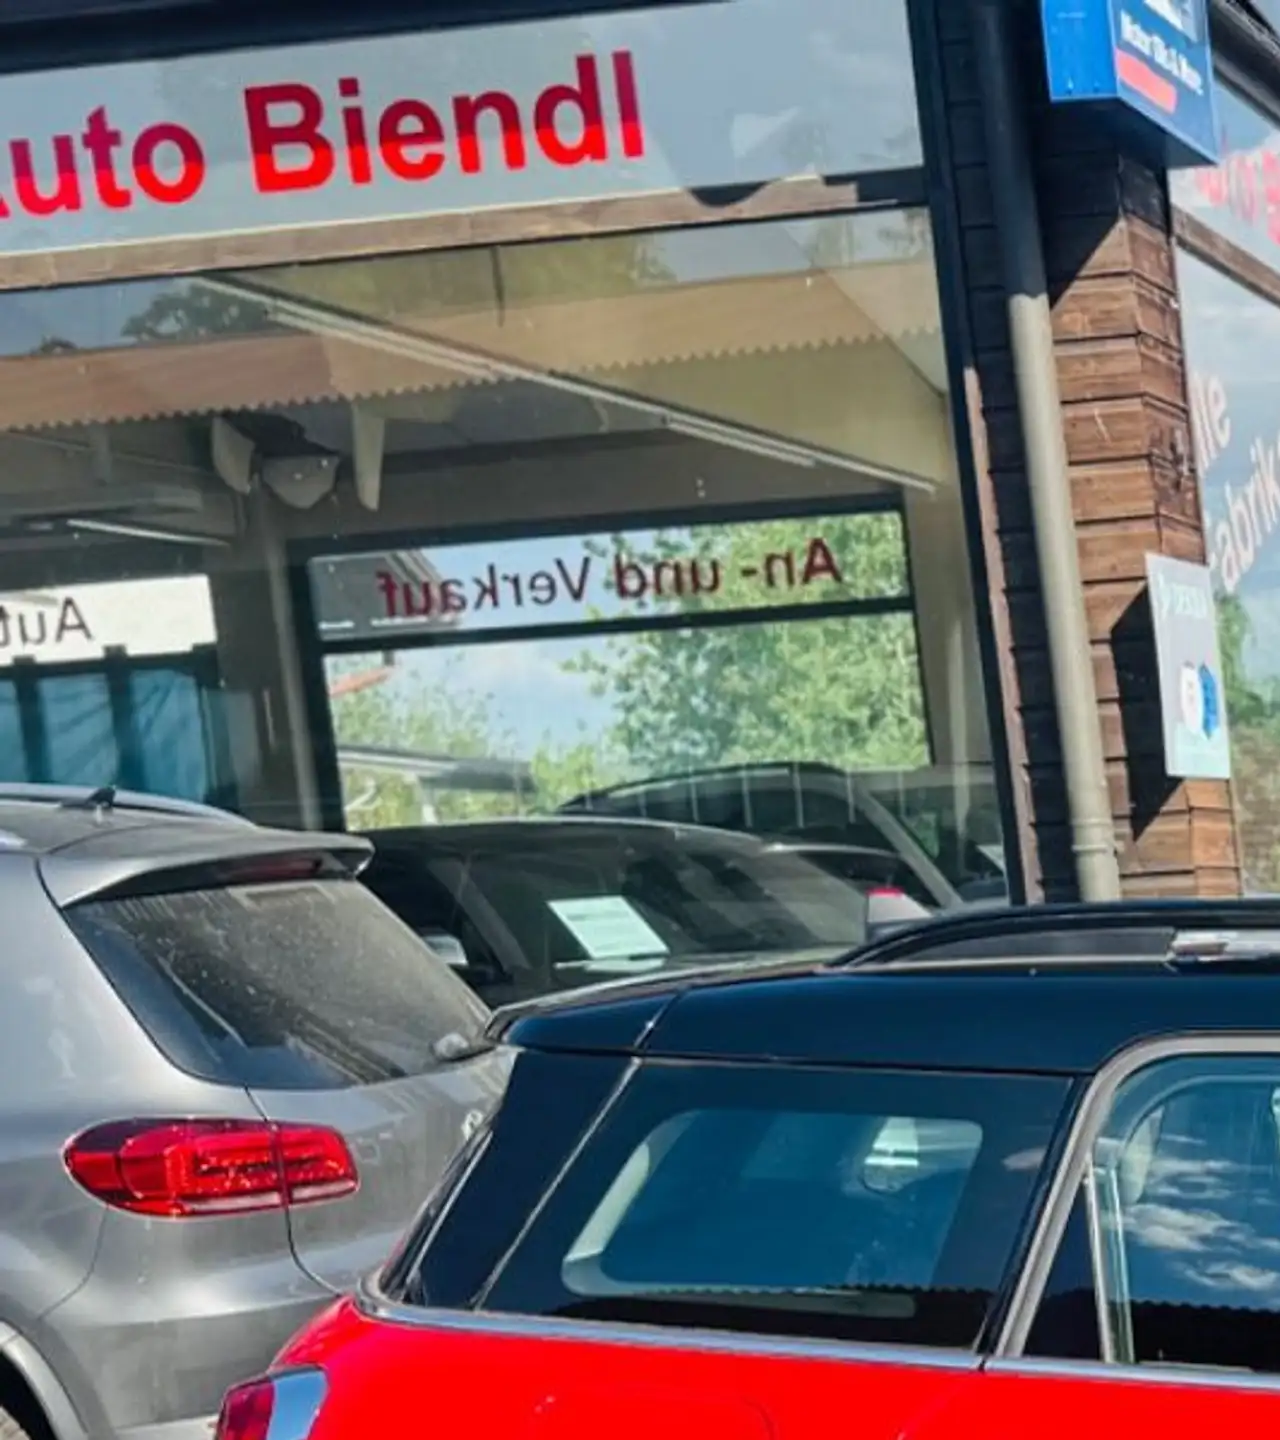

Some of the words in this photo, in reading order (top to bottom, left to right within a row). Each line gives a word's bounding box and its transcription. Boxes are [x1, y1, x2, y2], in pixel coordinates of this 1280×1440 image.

[0, 105, 206, 219] uto
[243, 50, 646, 194] Biendl
[1194, 371, 1232, 480] lle
